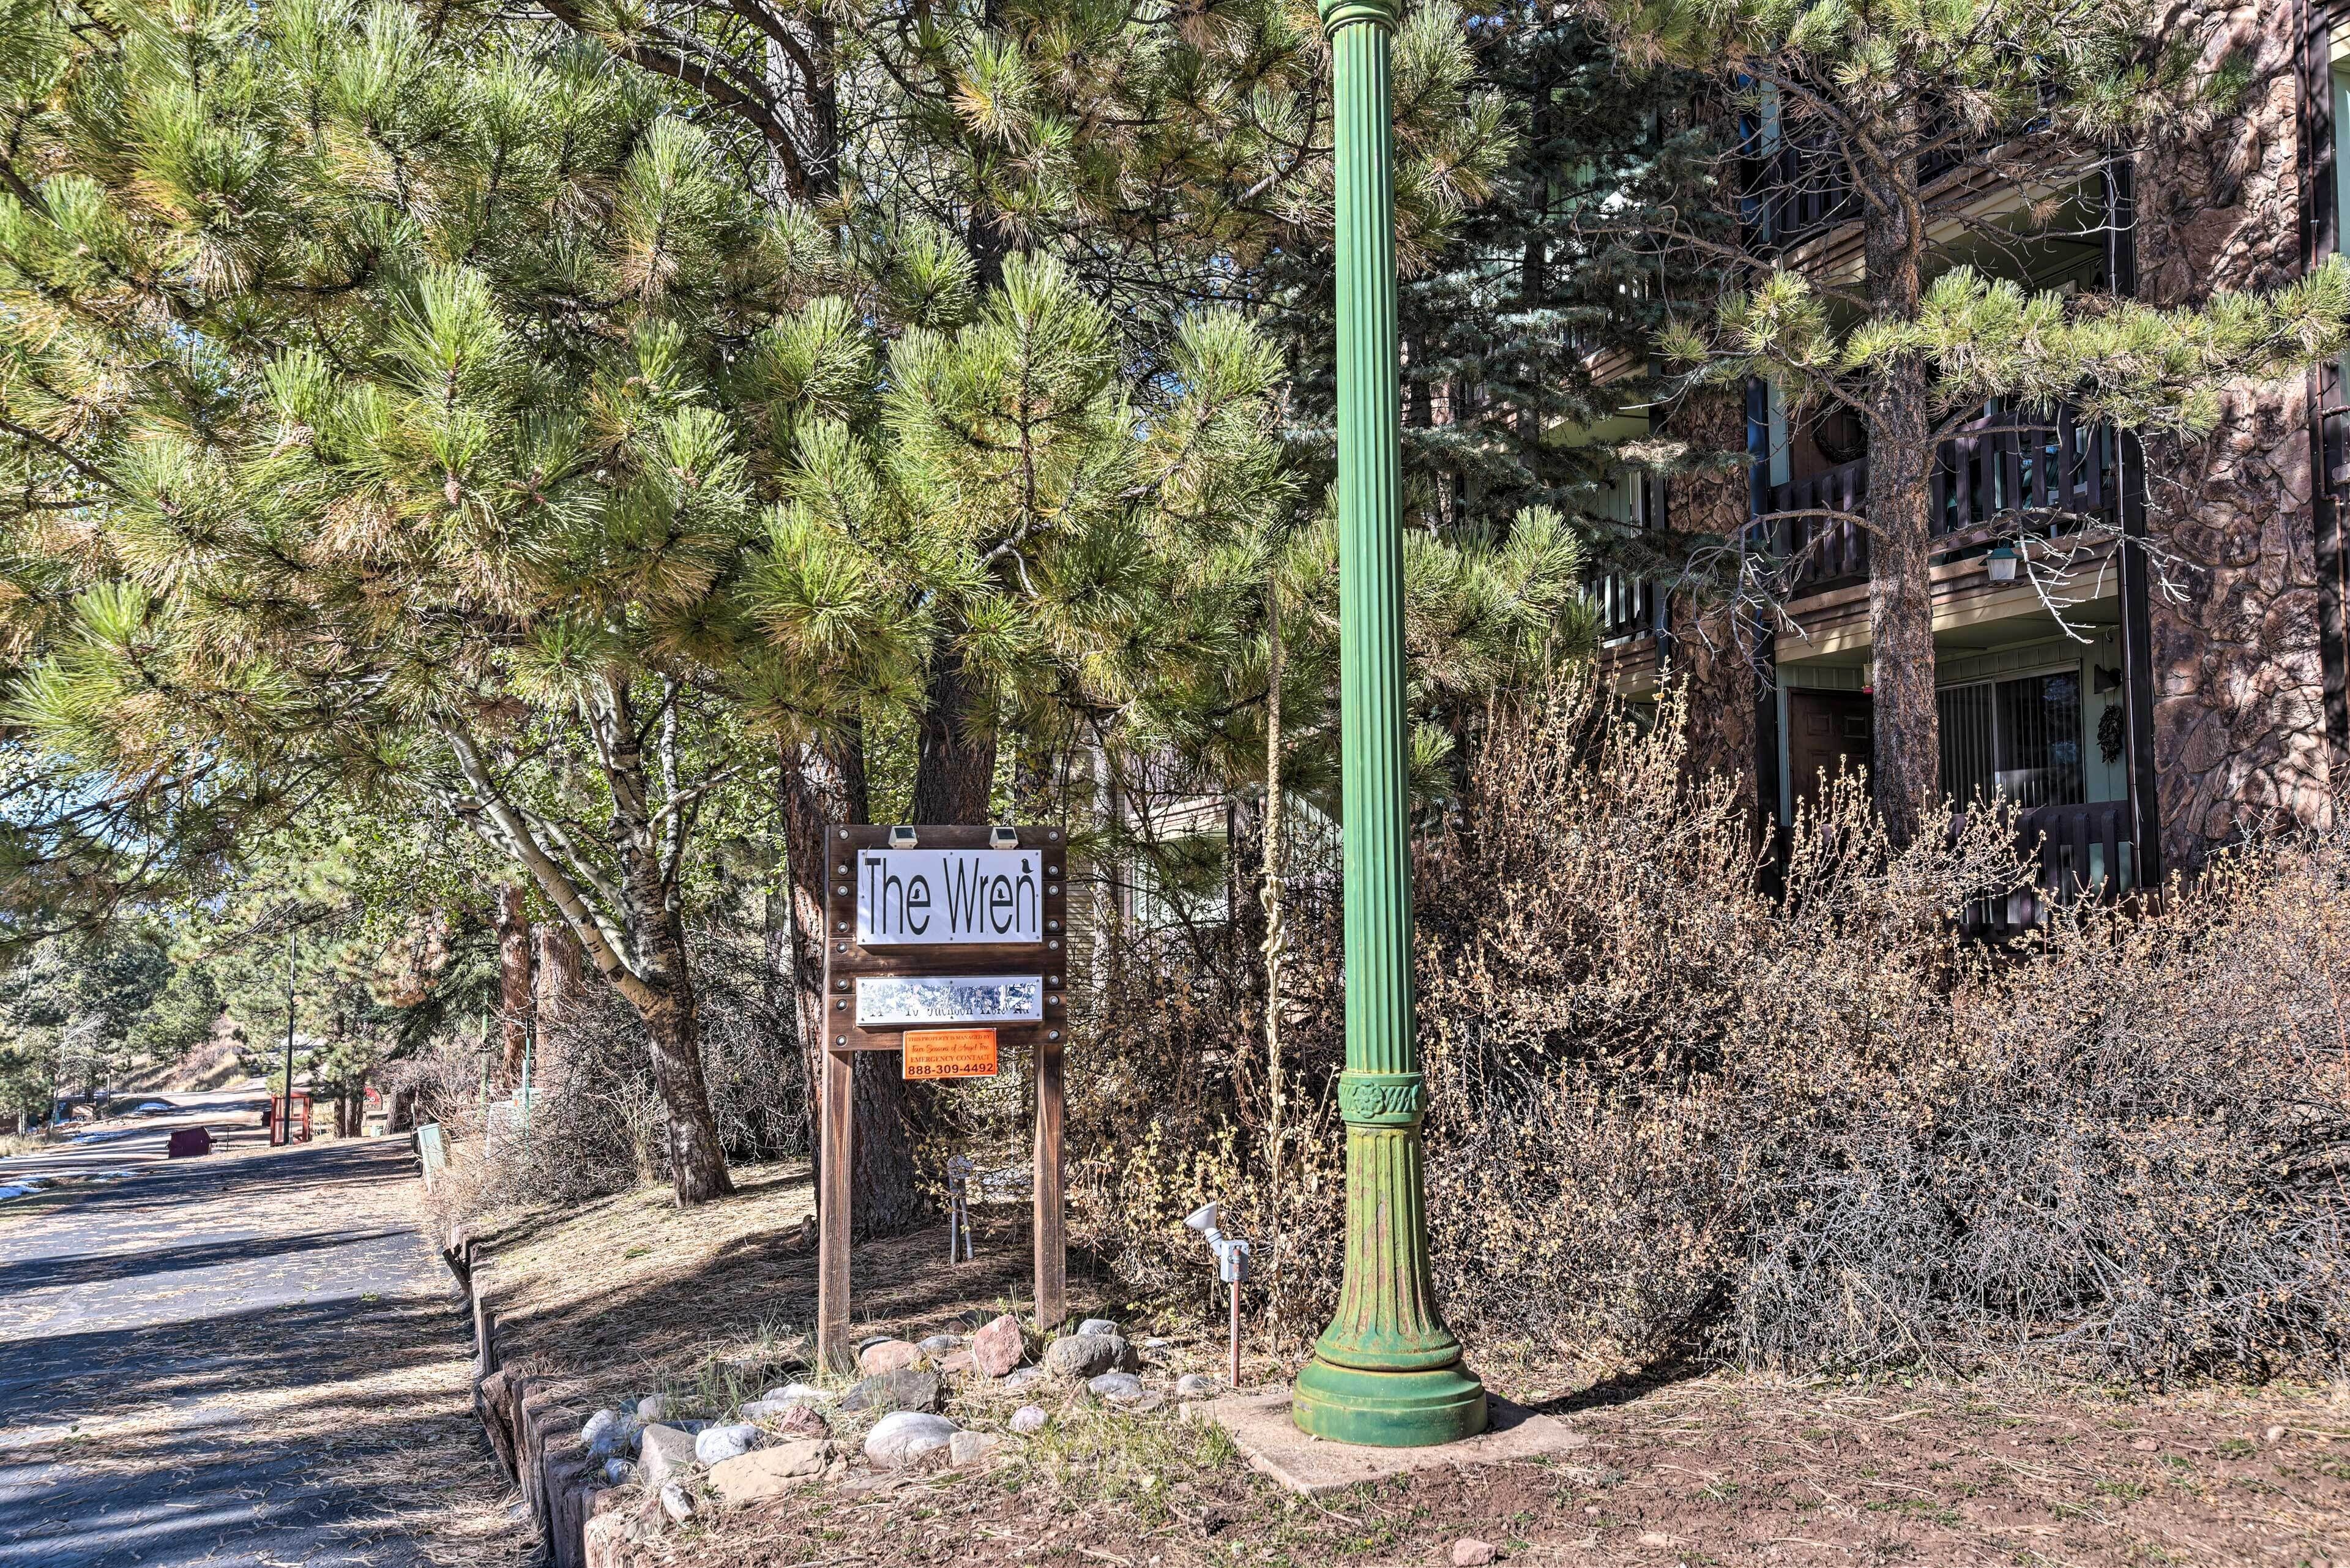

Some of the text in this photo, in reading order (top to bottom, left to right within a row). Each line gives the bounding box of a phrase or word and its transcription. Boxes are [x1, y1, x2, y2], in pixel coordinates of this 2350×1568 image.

[865, 858, 1035, 935] The Wren
[908, 1064, 993, 1075] 888-309-4492
